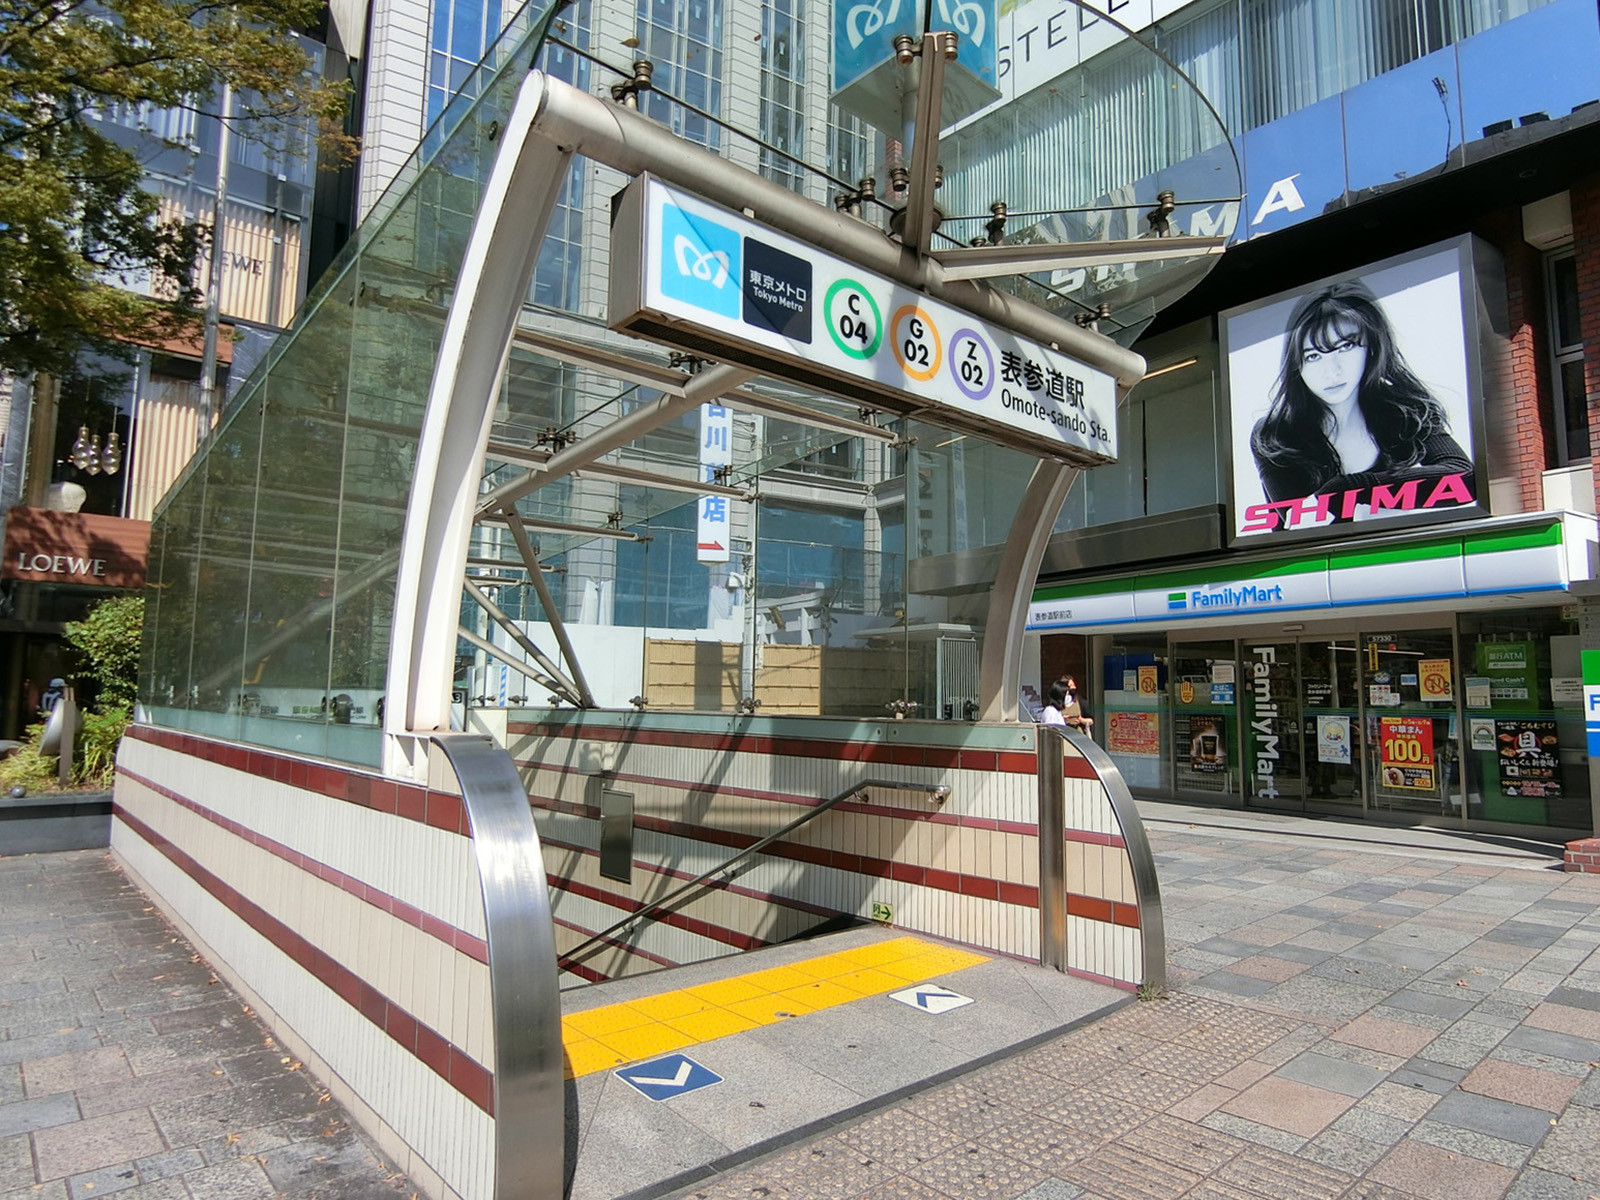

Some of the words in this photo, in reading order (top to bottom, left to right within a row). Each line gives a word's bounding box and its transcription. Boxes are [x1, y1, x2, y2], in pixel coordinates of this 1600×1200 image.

[750, 269, 807, 302] 東京メトロ
[753, 285, 778, 304] Tokyo
[778, 296, 803, 313] Metro
[848, 294, 860, 316] C
[840, 315, 868, 344] 04
[909, 318, 924, 339] G
[904, 339, 929, 367] 02
[967, 340, 977, 361] Z
[961, 360, 983, 386] 02
[1001, 350, 1085, 410] 表参道駅
[1001, 388, 1087, 435] Omote-sando
[1090, 420, 1112, 443] Sta.
[1240, 472, 1475, 533] SHIMA
[17, 552, 107, 576] LOEWE
[1192, 583, 1283, 608] FamilyMart
[1251, 647, 1280, 800] FamilyMart
